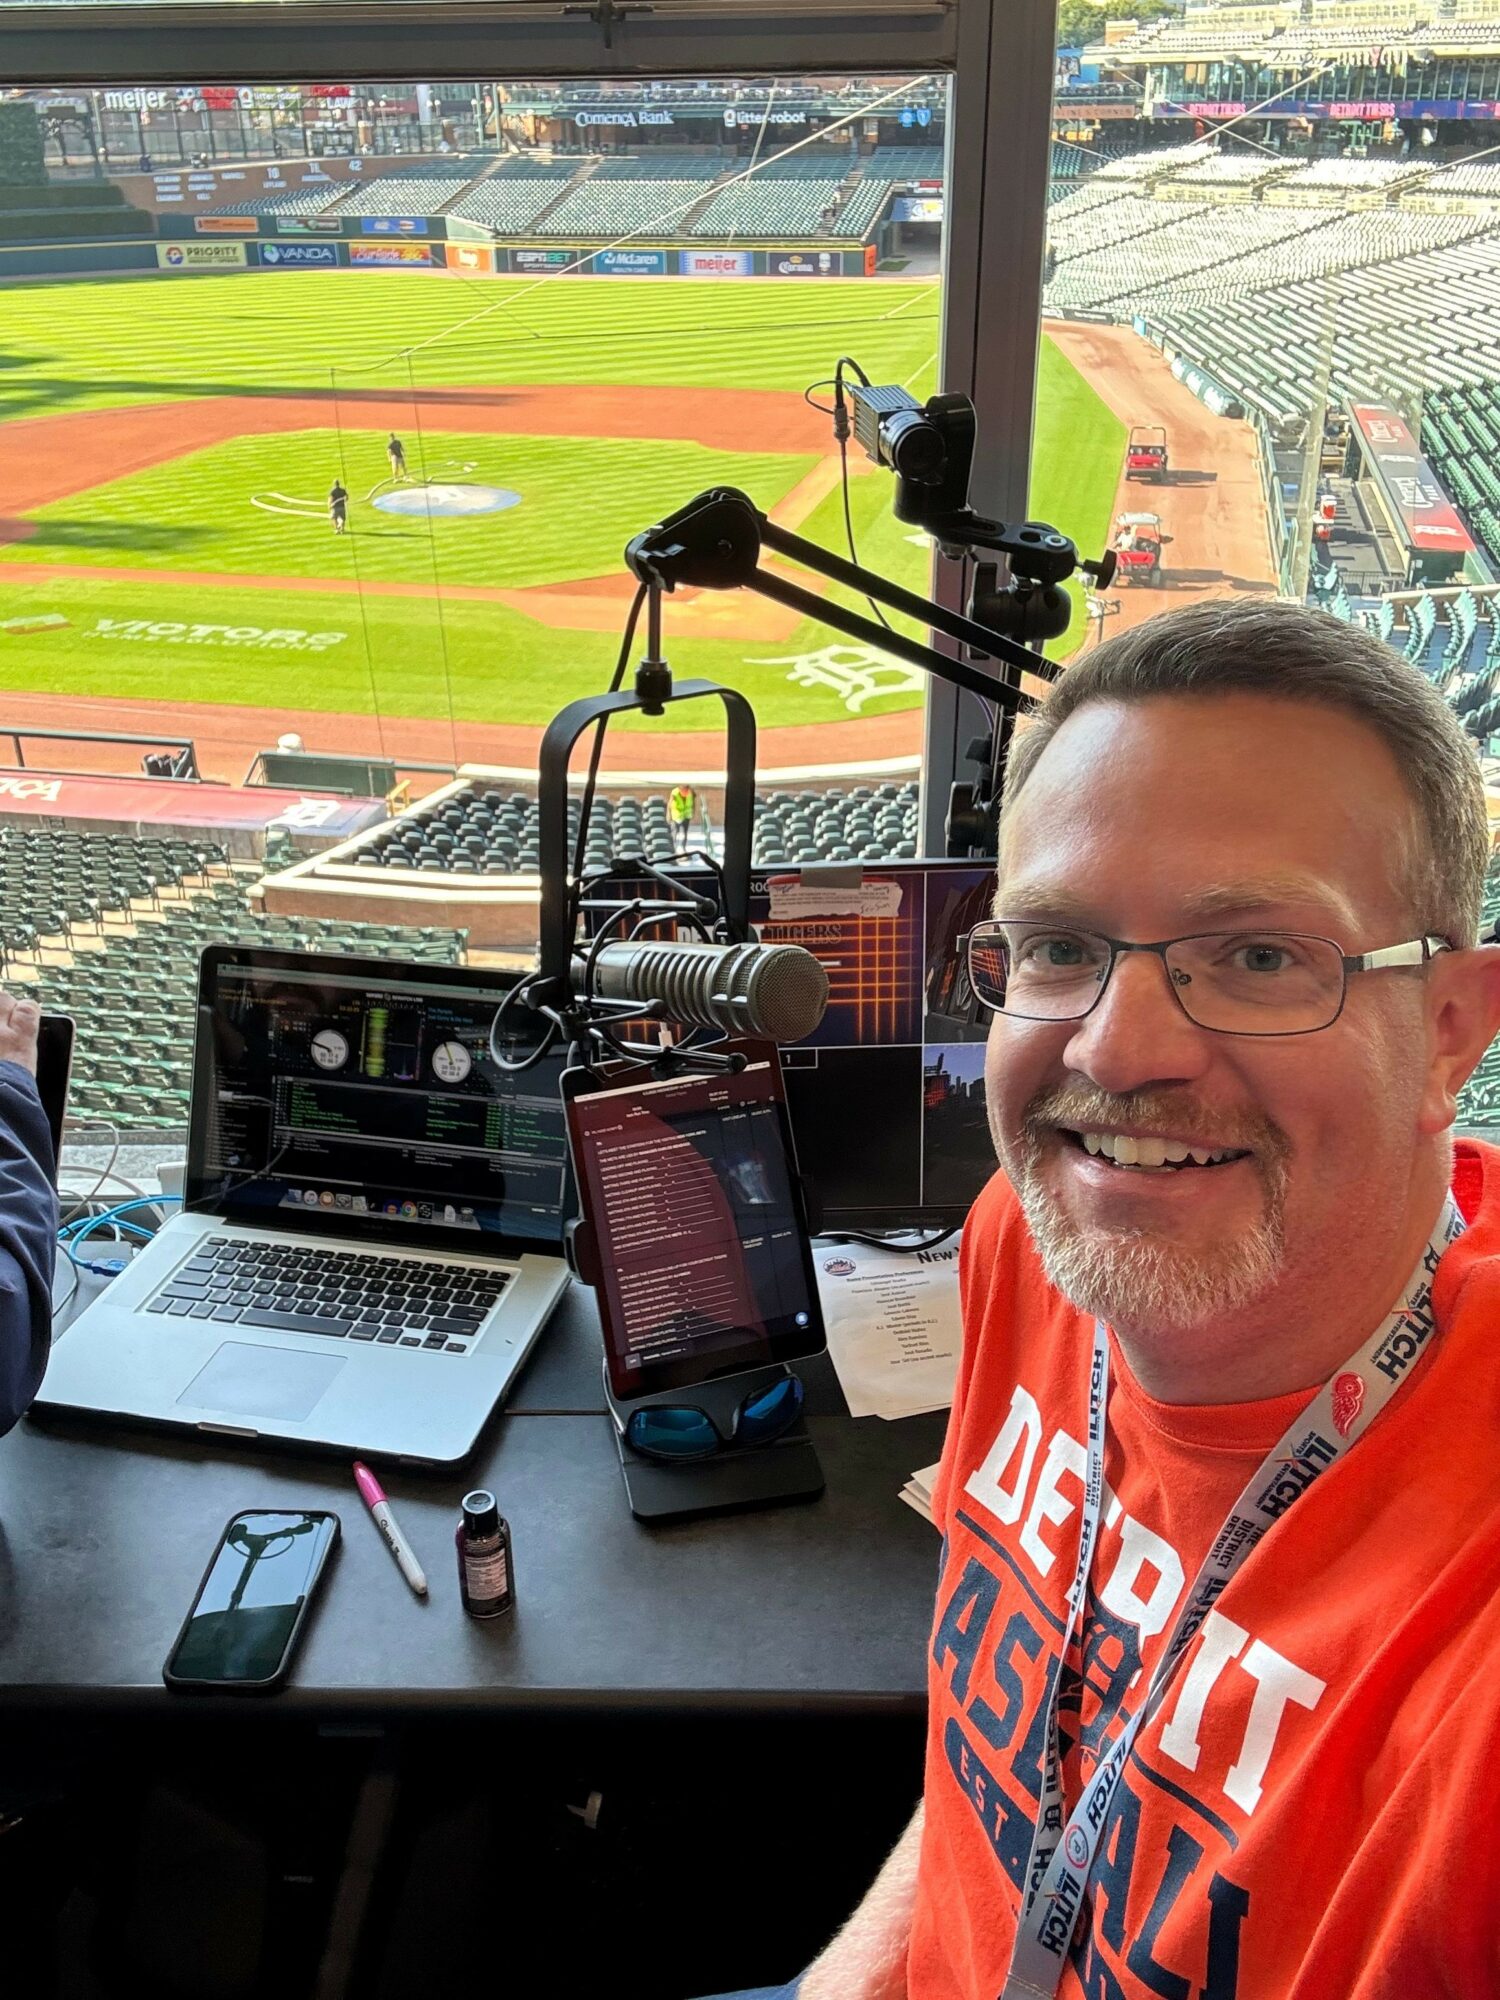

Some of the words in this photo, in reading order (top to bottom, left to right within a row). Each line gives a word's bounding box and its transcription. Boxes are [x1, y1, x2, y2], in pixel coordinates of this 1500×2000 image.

[104, 88, 167, 111] meijer
[638, 111, 674, 125] Bank
[186, 246, 238, 257] PRIORITY
[279, 247, 333, 259] VANDA
[616, 252, 658, 264] McLaren
[695, 258, 737, 270] meijer
[95, 618, 348, 645] VICTORS
[769, 923, 842, 944] TIGERS
[1089, 1349, 1102, 1441] ILITCH
[1261, 1436, 1338, 1519] ILITCH
[1211, 1515, 1241, 1560] DETROIT
[1217, 1519, 1255, 1570] DISTRICT
[964, 1385, 1327, 1816] DERIT
[1043, 1870, 1081, 1958] ILITCH
